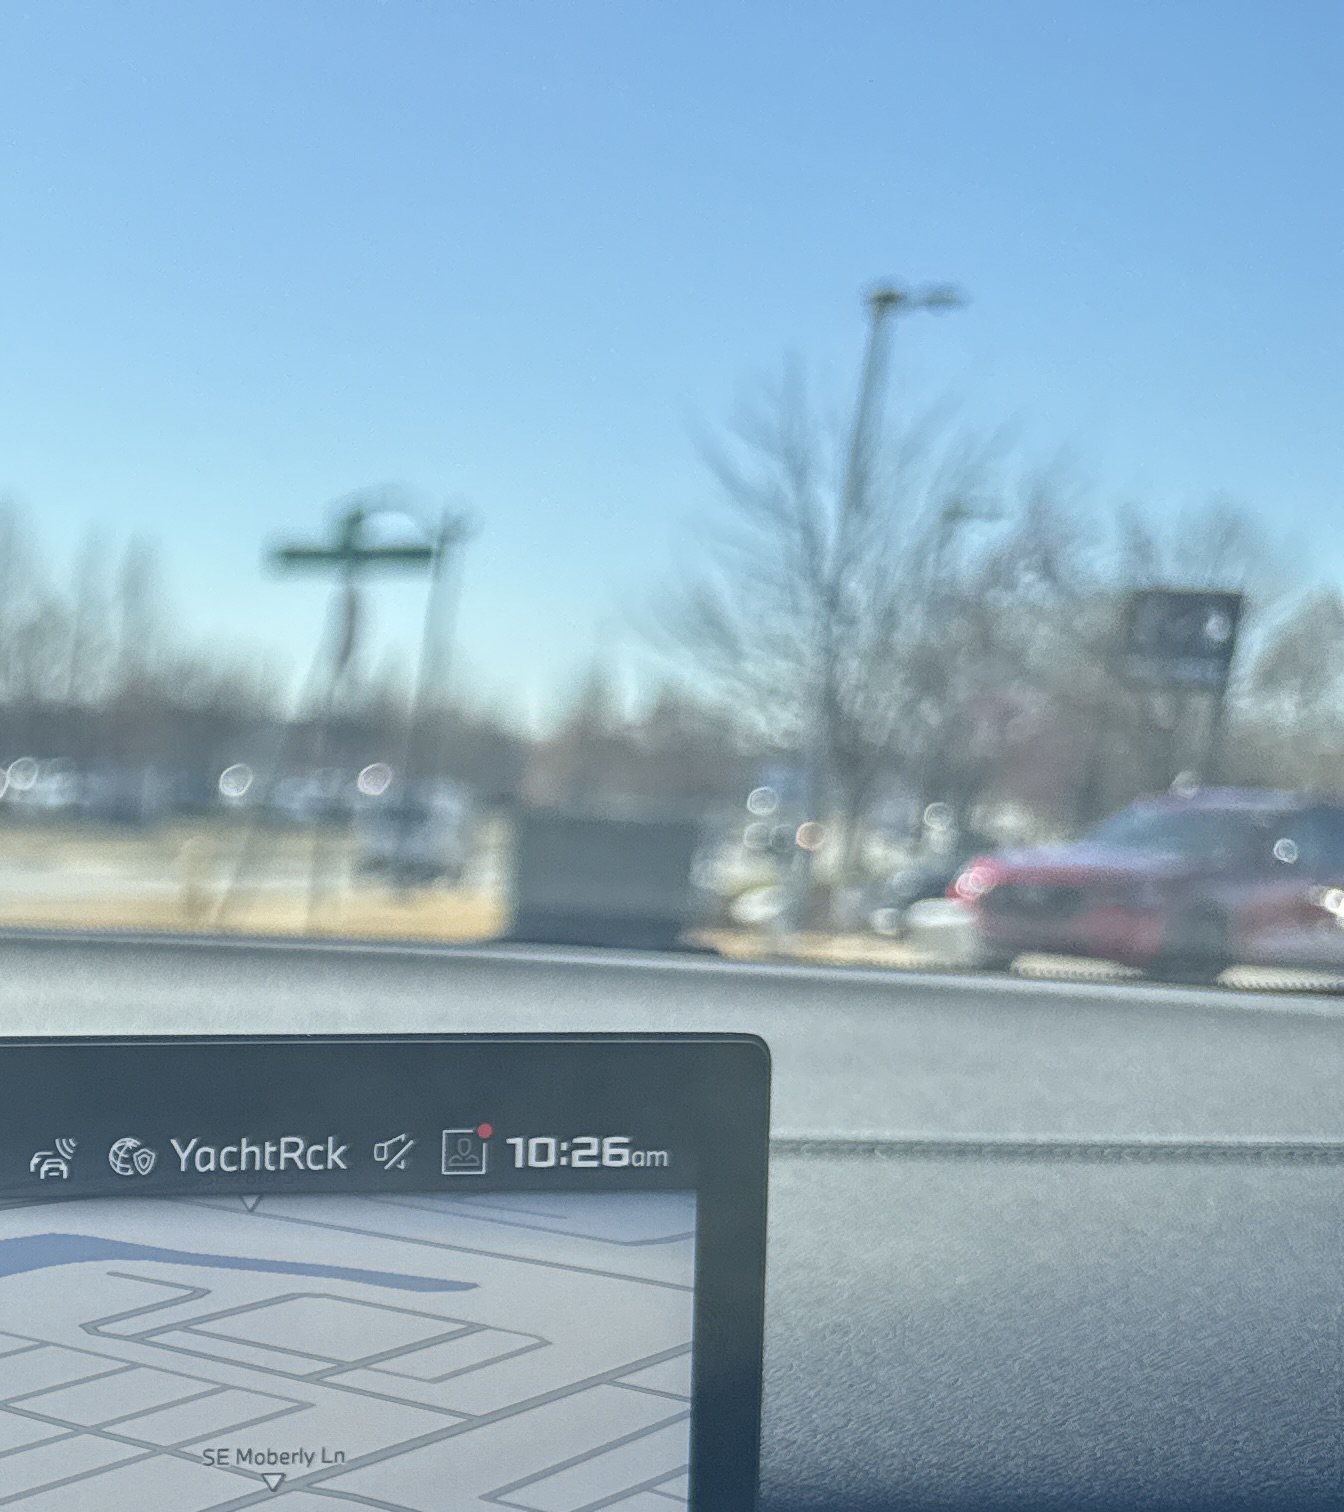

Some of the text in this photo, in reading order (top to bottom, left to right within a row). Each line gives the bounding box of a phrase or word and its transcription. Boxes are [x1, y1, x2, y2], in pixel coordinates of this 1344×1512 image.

[170, 1137, 348, 1174] YachtRck
[202, 1447, 346, 1468] SE Moberly Ln
